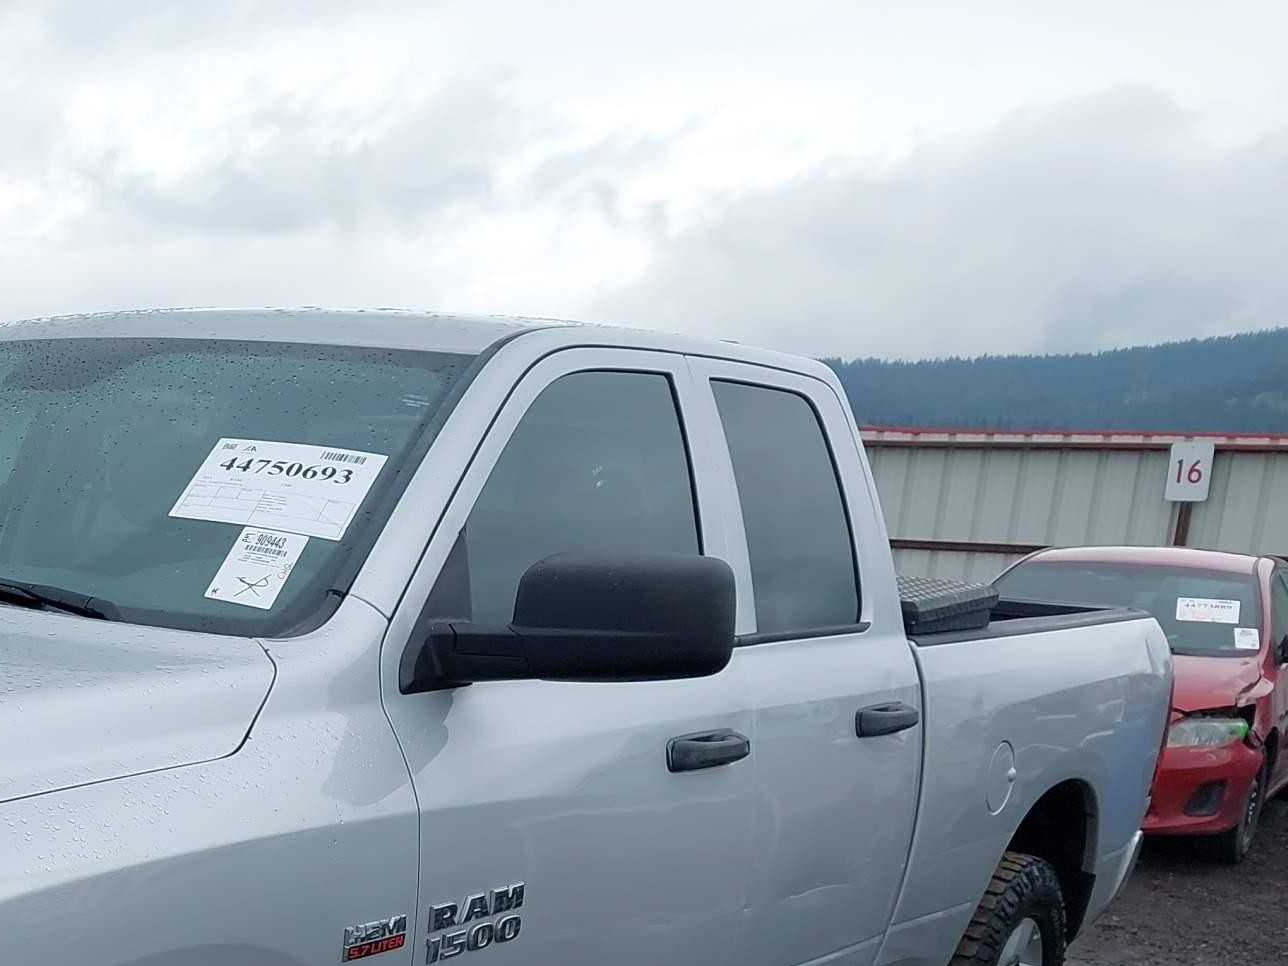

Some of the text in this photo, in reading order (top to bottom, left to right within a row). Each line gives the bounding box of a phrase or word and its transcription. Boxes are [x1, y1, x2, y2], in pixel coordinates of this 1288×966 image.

[220, 456, 354, 485] 44750693
[1176, 459, 1202, 483] 16
[255, 533, 287, 549] 909443
[427, 880, 526, 934] RAM
[424, 914, 522, 965] 1500
